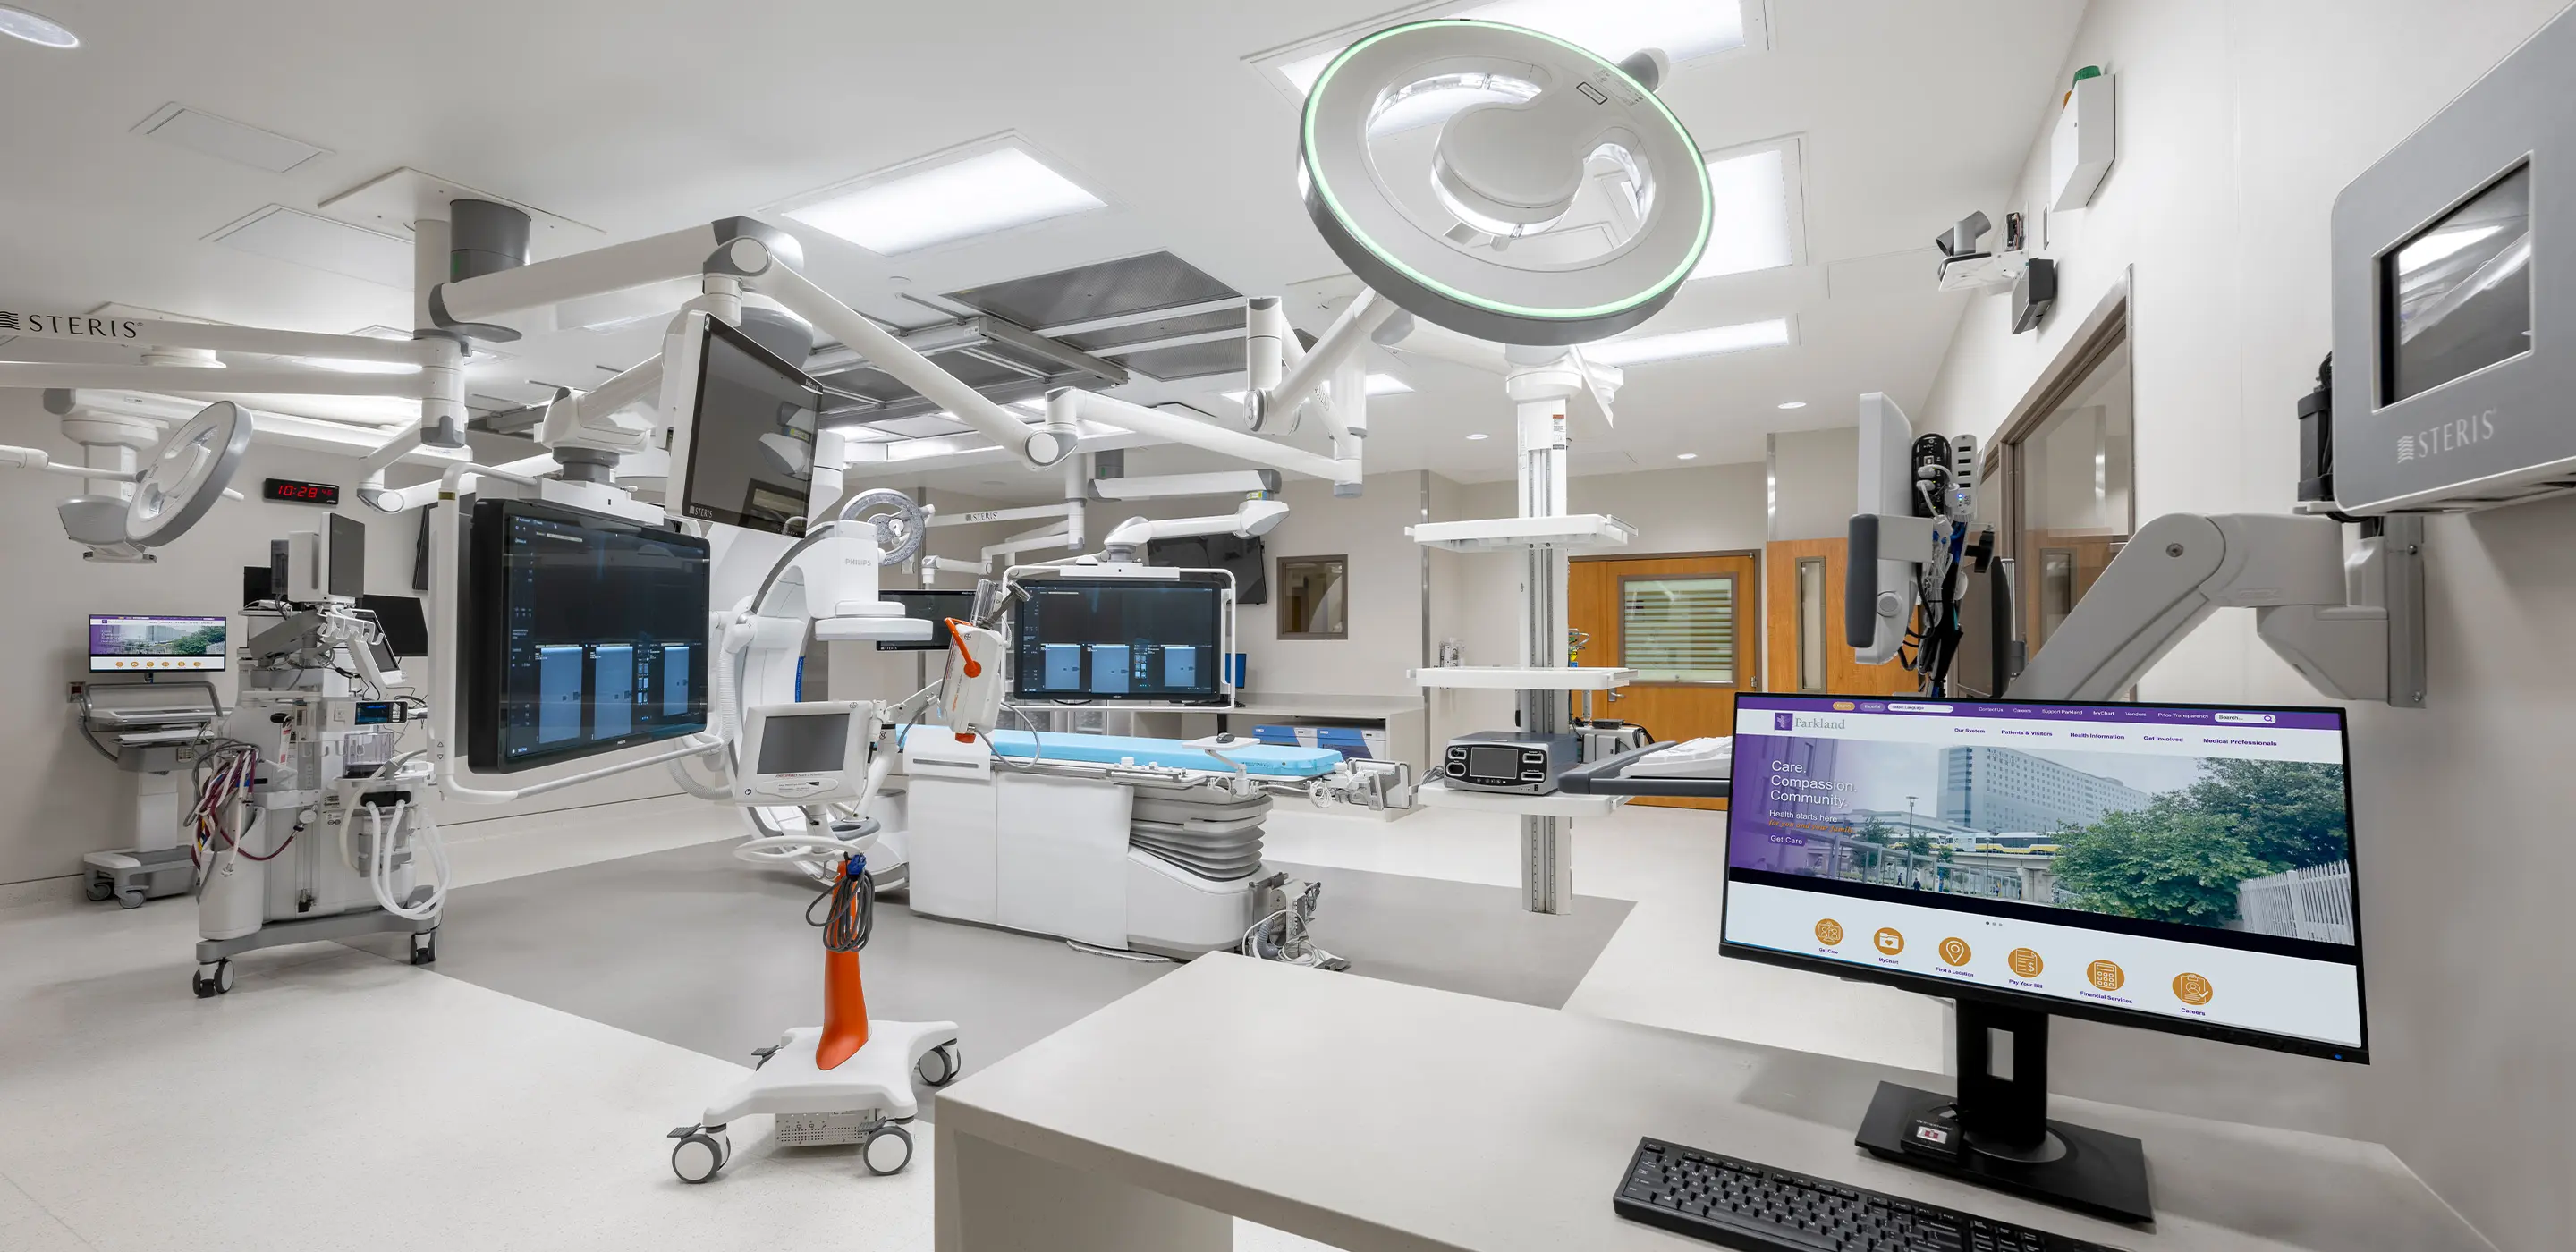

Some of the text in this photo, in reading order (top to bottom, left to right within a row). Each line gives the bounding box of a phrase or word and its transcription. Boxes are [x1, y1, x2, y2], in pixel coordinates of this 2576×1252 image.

[2419, 410, 2495, 458] STERIS
[278, 485, 318, 498] 10:28
[695, 507, 713, 519] STERIS
[973, 512, 998, 521] STERIS
[845, 558, 871, 566] PHILIPS
[2042, 708, 2060, 716] Support
[1795, 717, 1845, 730] Parkland
[2230, 740, 2277, 748] Professionals
[1772, 760, 1806, 774] Care.
[1771, 775, 1857, 792] Compassion.
[1770, 791, 1848, 809] Community.
[1769, 810, 1837, 823] Health starts here
[1785, 837, 1802, 845] Care
[1878, 957, 1898, 965] MyChart
[1952, 969, 1974, 977] Location
[2080, 990, 2133, 1004] Financial Services
[2181, 1007, 2206, 1016] Careers
